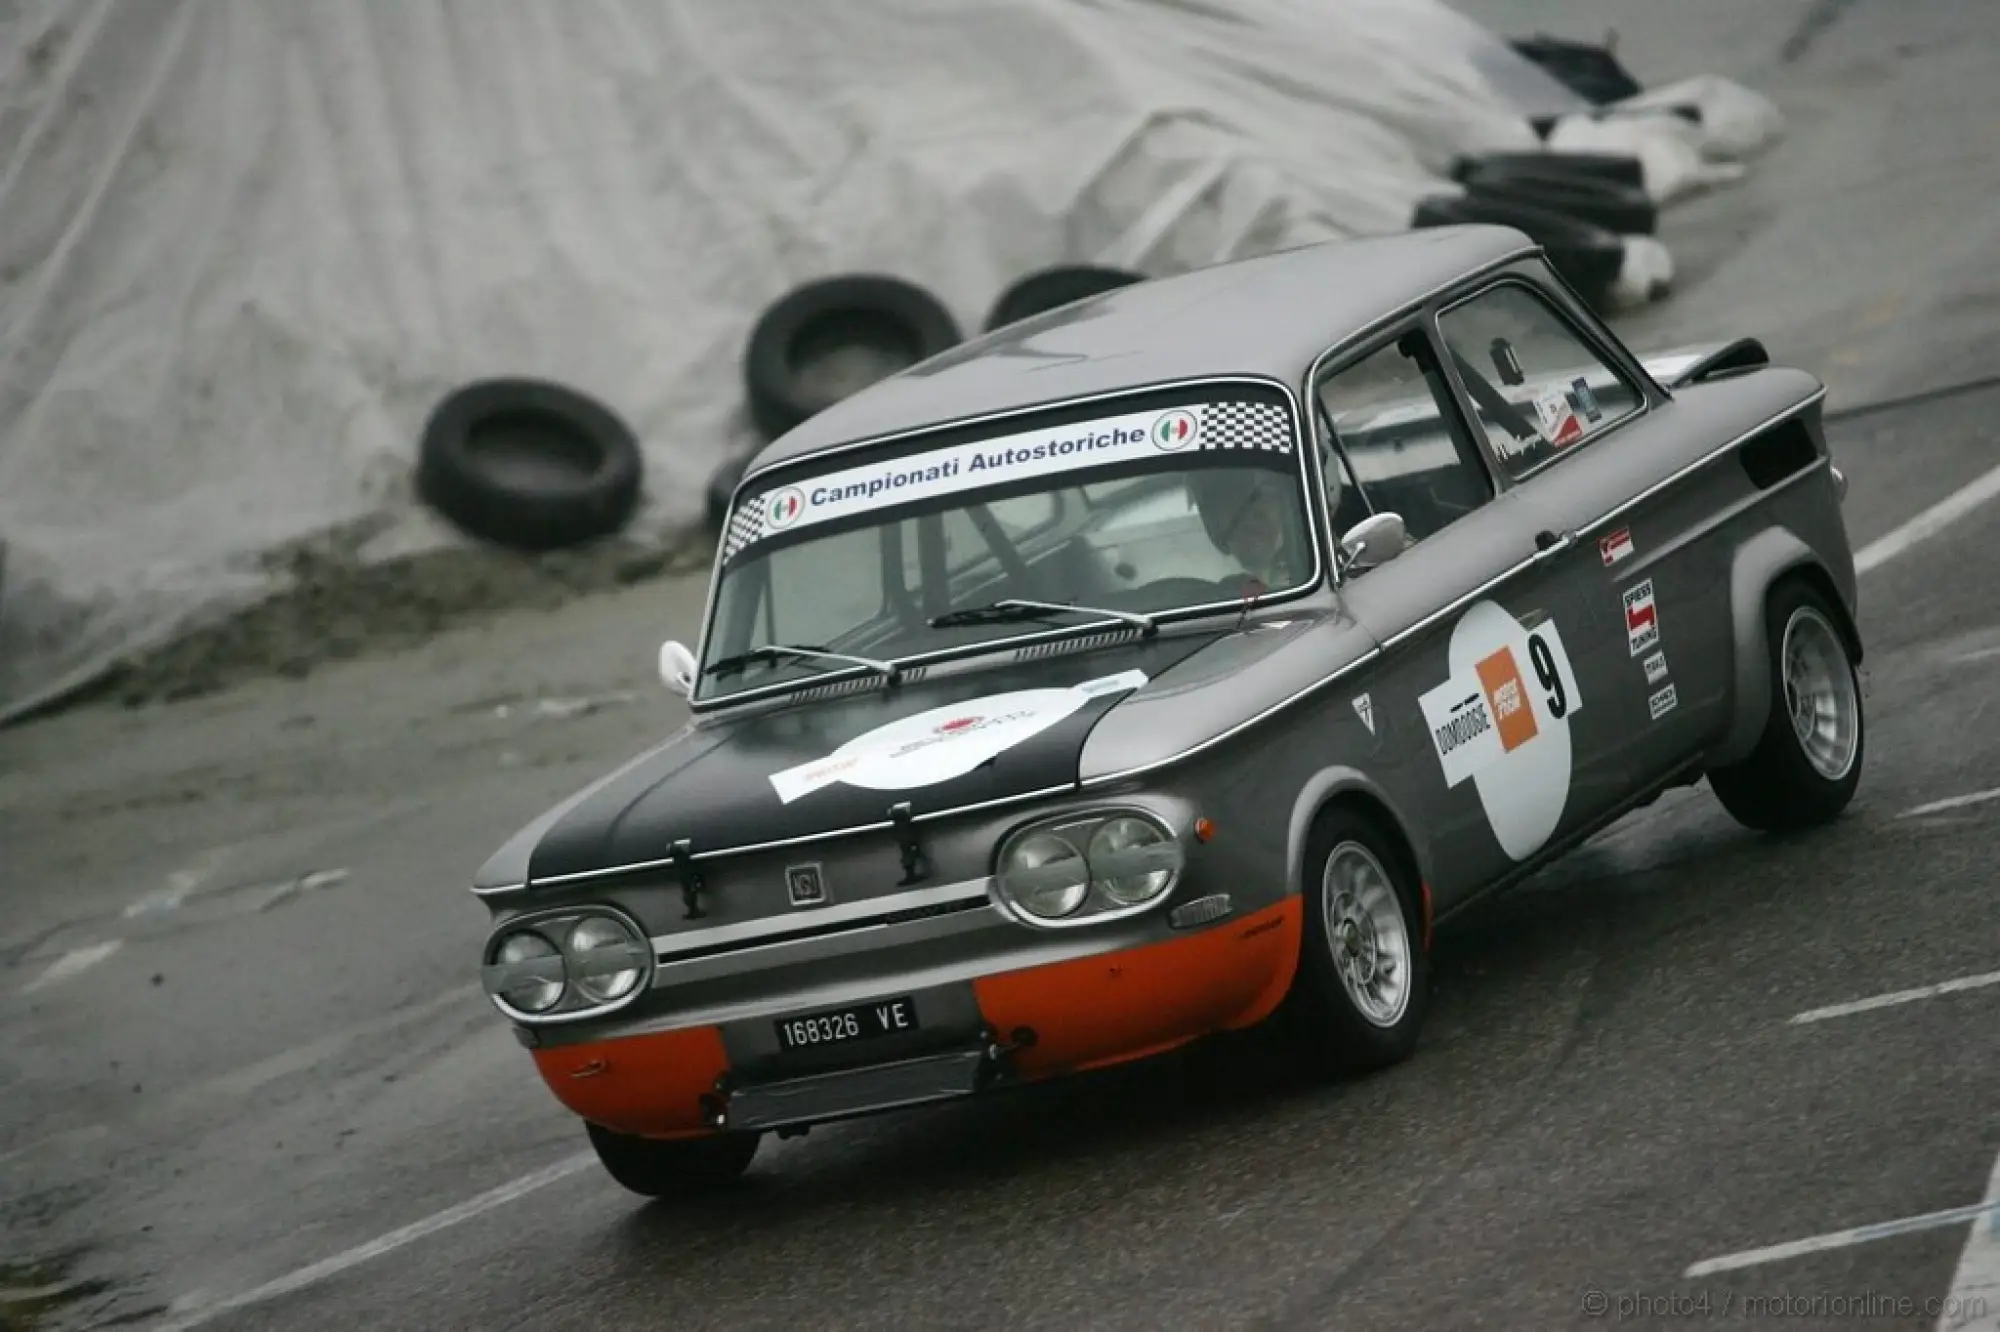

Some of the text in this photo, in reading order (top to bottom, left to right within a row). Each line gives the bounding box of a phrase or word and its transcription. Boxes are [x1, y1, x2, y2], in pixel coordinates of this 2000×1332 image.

[811, 426, 1146, 506] Campionati Autostoriche
[1528, 633, 1567, 719] 9
[784, 1003, 909, 1047] 168326 VE
